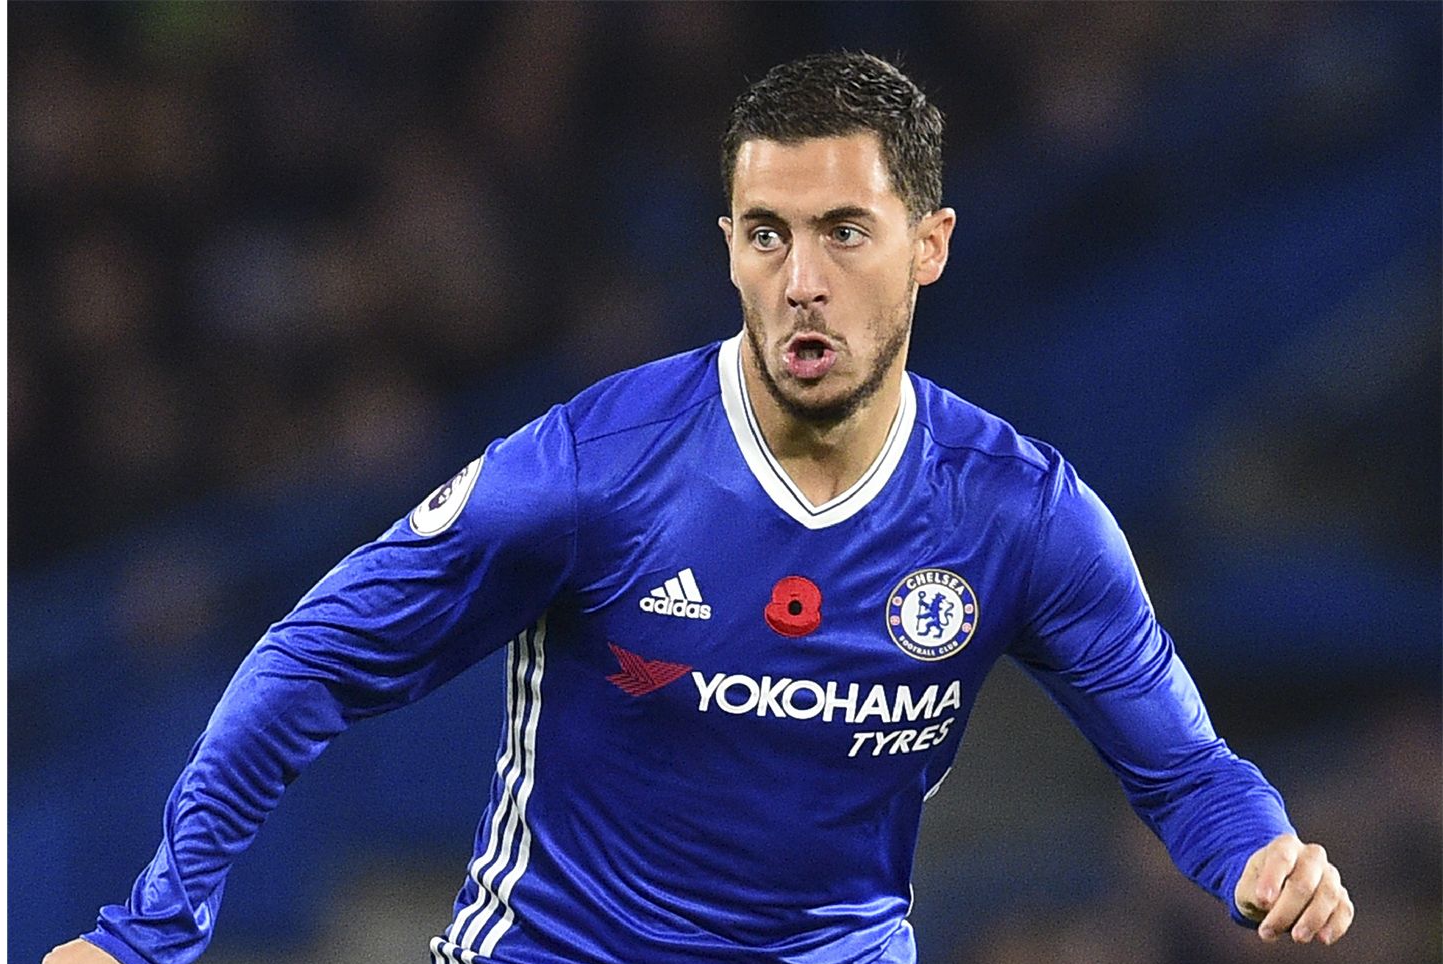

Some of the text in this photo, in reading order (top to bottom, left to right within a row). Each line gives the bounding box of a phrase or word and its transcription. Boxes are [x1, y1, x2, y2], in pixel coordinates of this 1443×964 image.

[906, 572, 965, 596] CHELSEA
[639, 594, 712, 621] adidas
[898, 635, 959, 656] FOOTBALL CLUB
[691, 671, 961, 724] YOKOHAMA
[847, 716, 955, 758] TYRES
